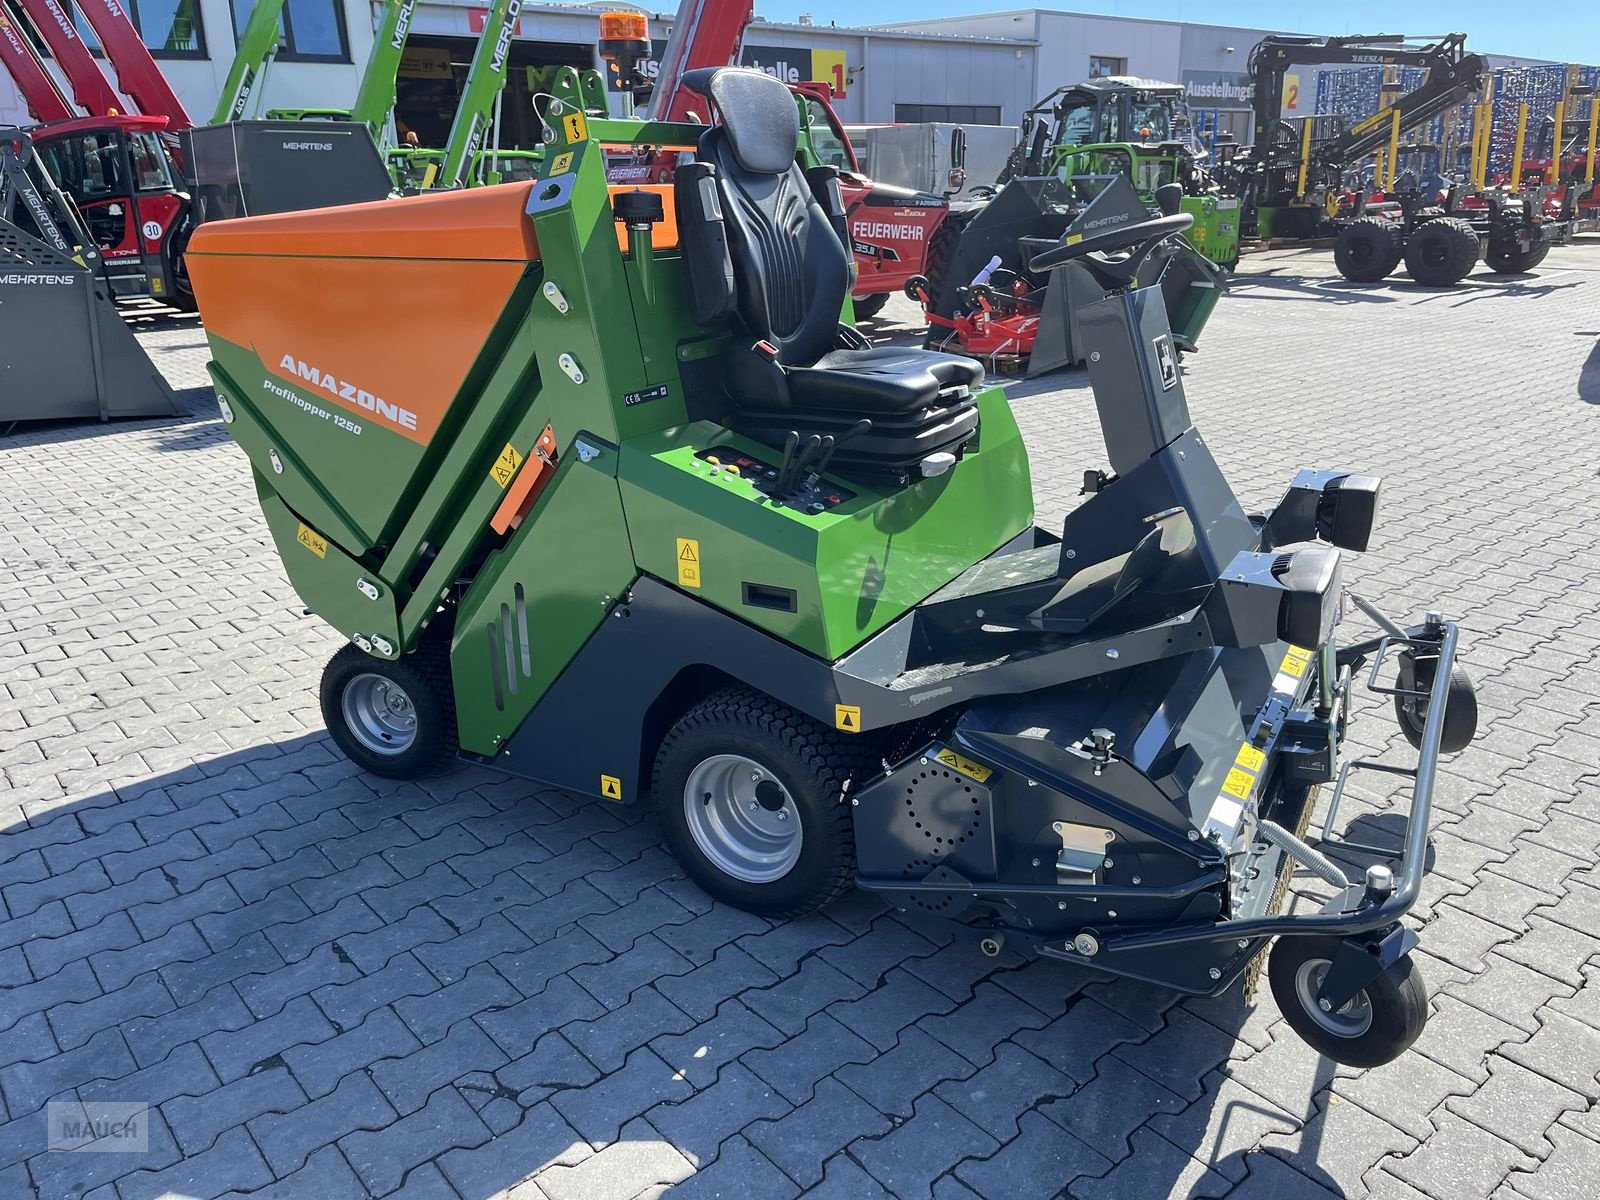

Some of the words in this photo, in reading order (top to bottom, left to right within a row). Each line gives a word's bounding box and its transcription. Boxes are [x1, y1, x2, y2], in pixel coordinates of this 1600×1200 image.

[490, 0, 521, 73] MERLO
[831, 63, 847, 99] 1
[1287, 84, 1298, 110] 2
[282, 142, 333, 151] MEHRTENS
[467, 132, 480, 158] 27.6
[22, 188, 68, 250] MEHRTENS
[145, 224, 160, 236] 30
[852, 221, 924, 241] FEUERWEHR
[0, 274, 75, 285] MEHRTENS
[279, 353, 418, 431] AMAZONE
[263, 379, 332, 420] Profihopper
[333, 414, 362, 436] 1250
